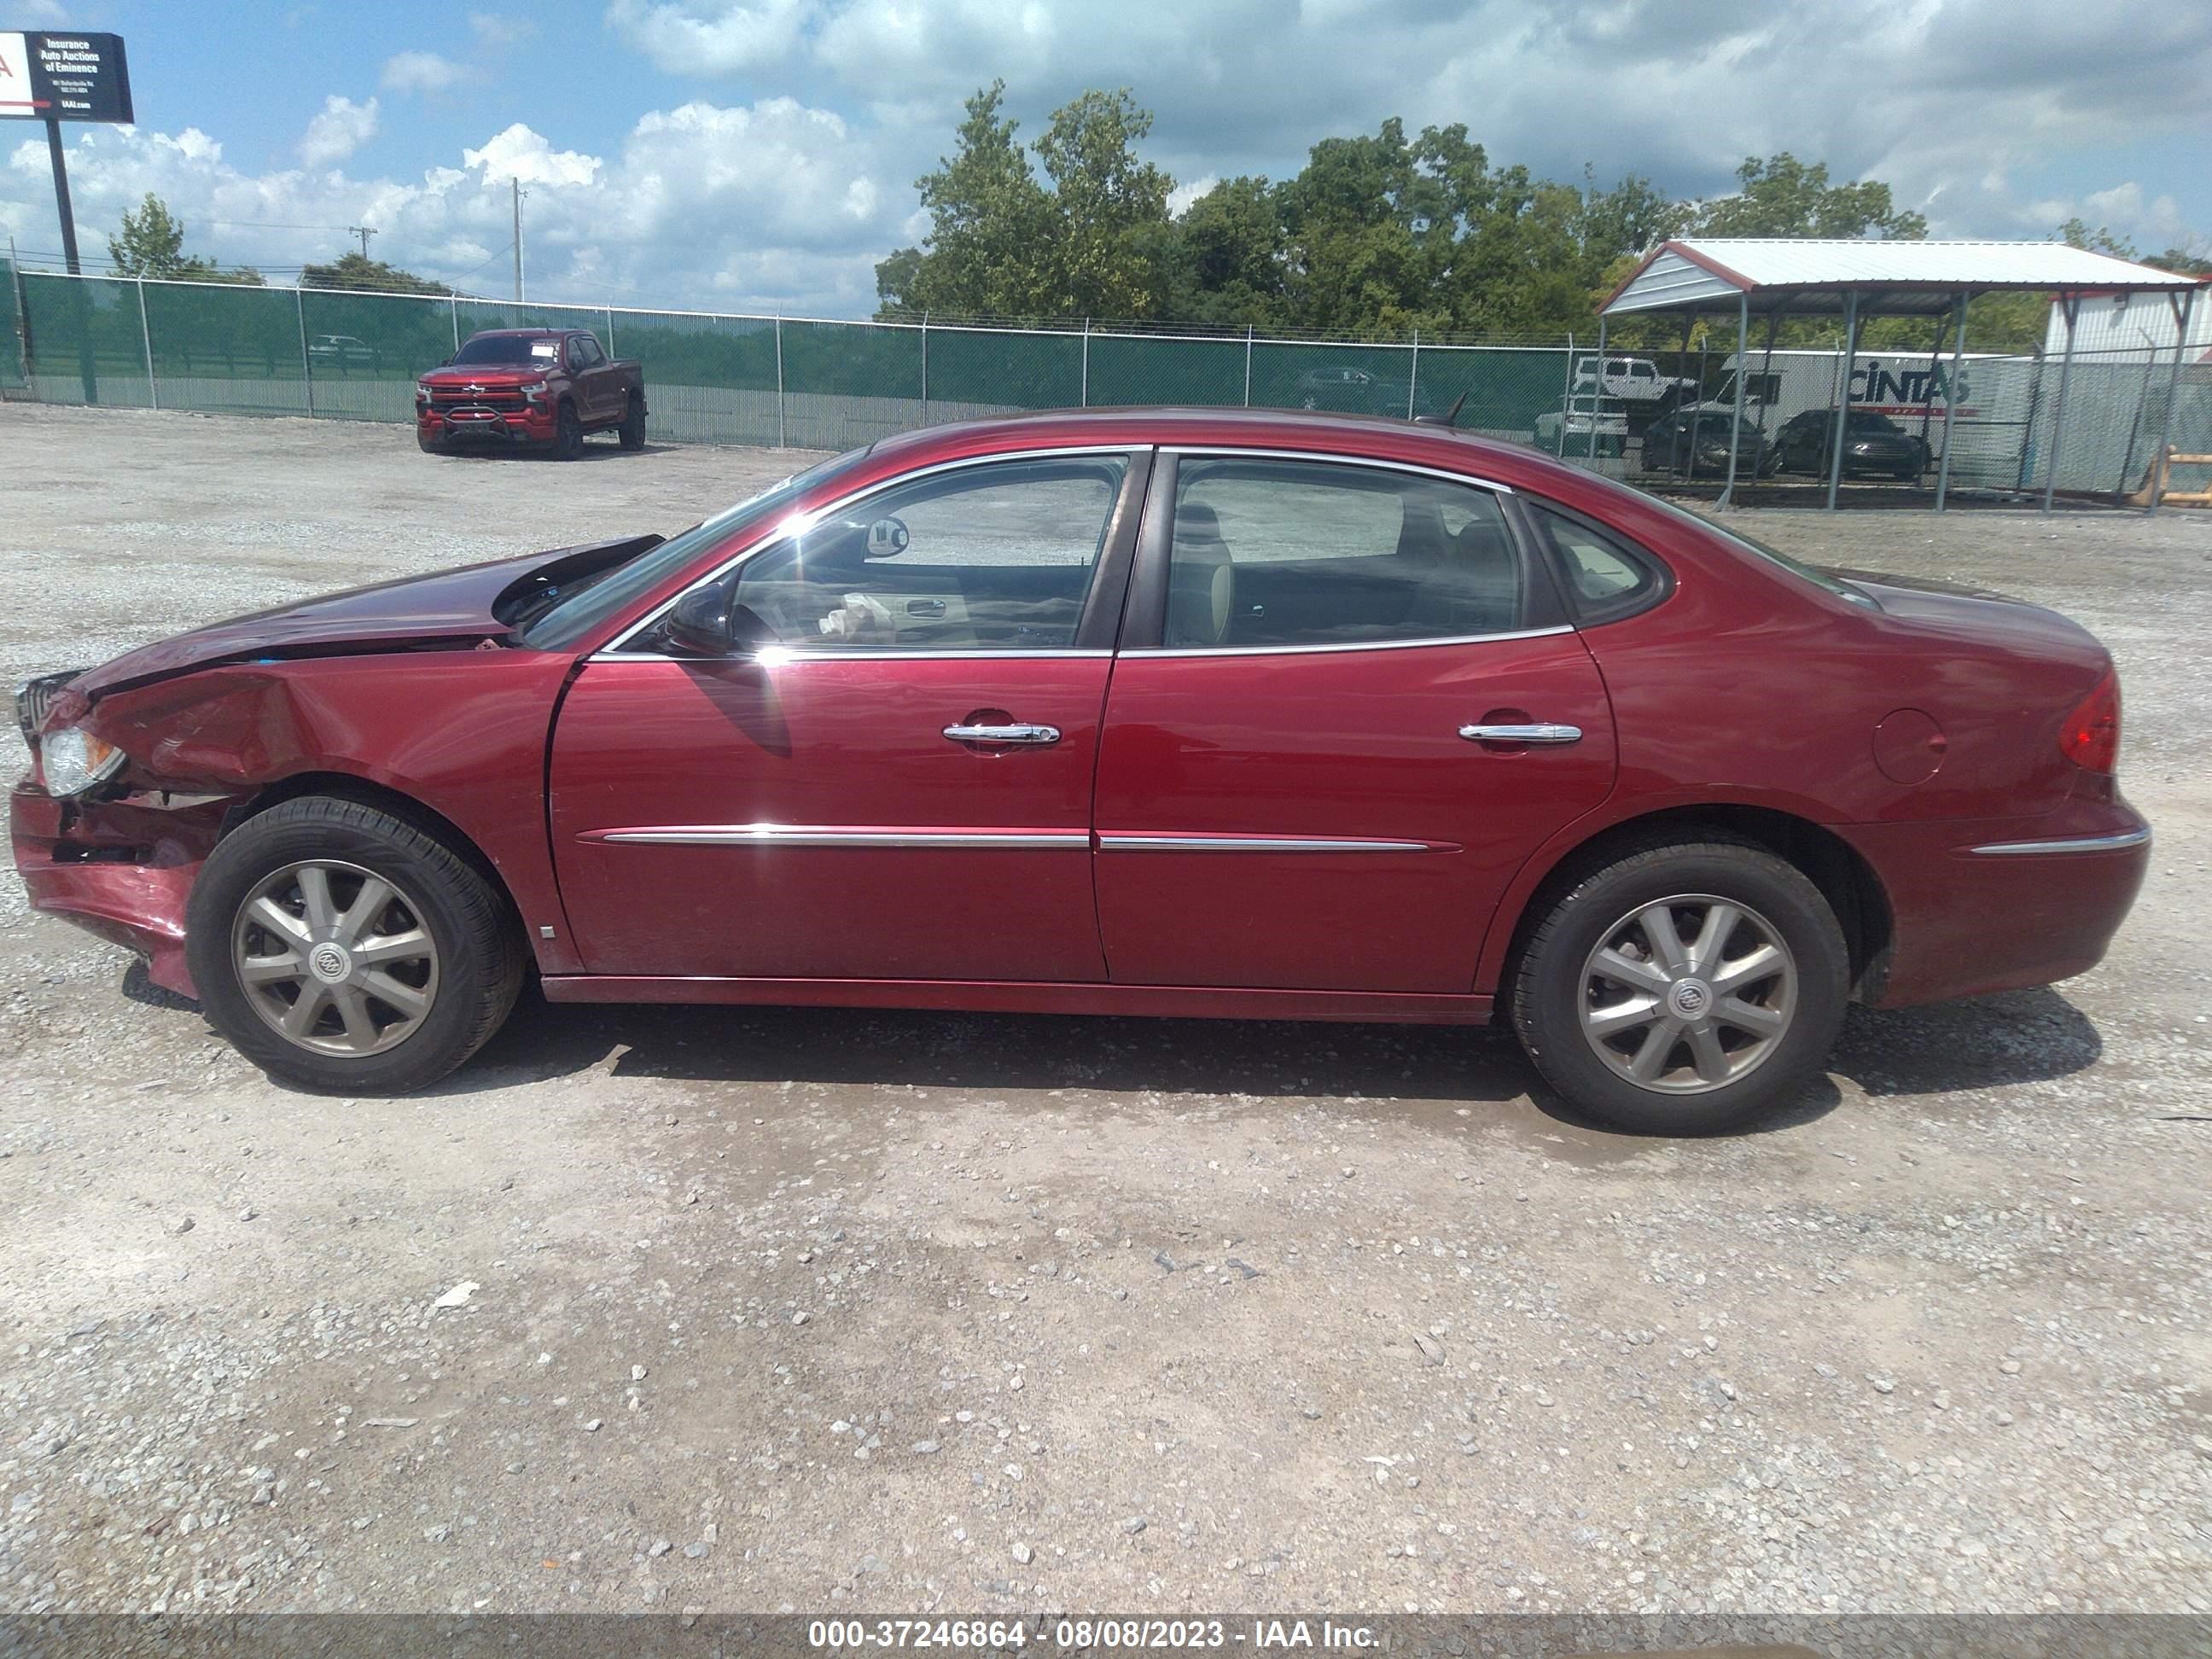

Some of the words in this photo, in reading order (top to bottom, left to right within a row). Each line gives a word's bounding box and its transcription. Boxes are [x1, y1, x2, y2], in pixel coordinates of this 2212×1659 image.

[47, 38, 90, 49] Insurance
[41, 49, 61, 61] Auto
[63, 50, 101, 61] Auctions
[45, 61, 55, 72] of
[56, 62, 98, 73] Eminence
